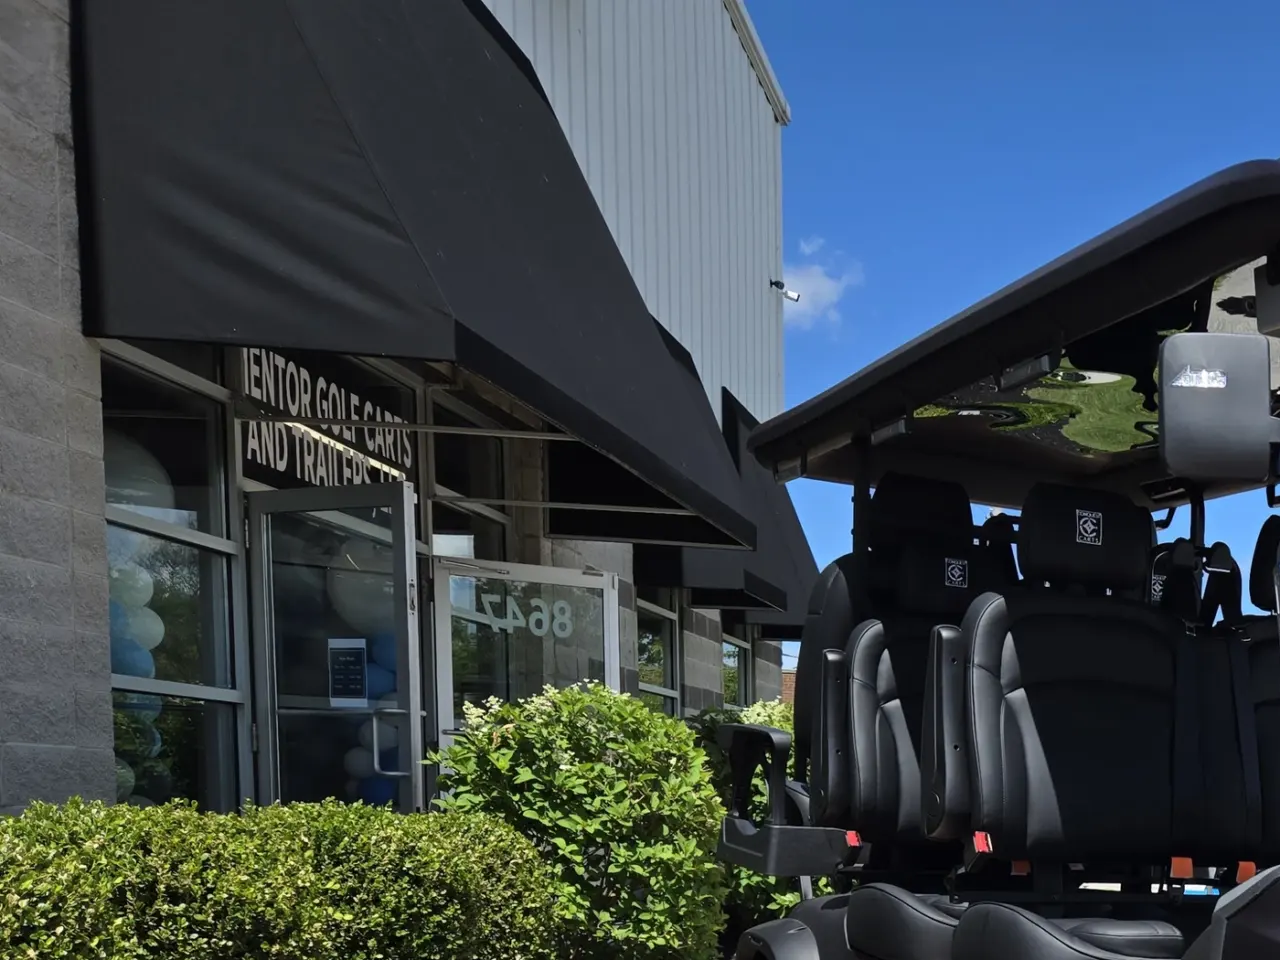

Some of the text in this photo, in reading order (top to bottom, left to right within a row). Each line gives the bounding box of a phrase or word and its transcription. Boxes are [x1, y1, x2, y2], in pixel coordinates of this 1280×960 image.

[247, 419, 288, 472] AND
[316, 376, 360, 443] GOLF
[363, 400, 412, 469] CARTS
